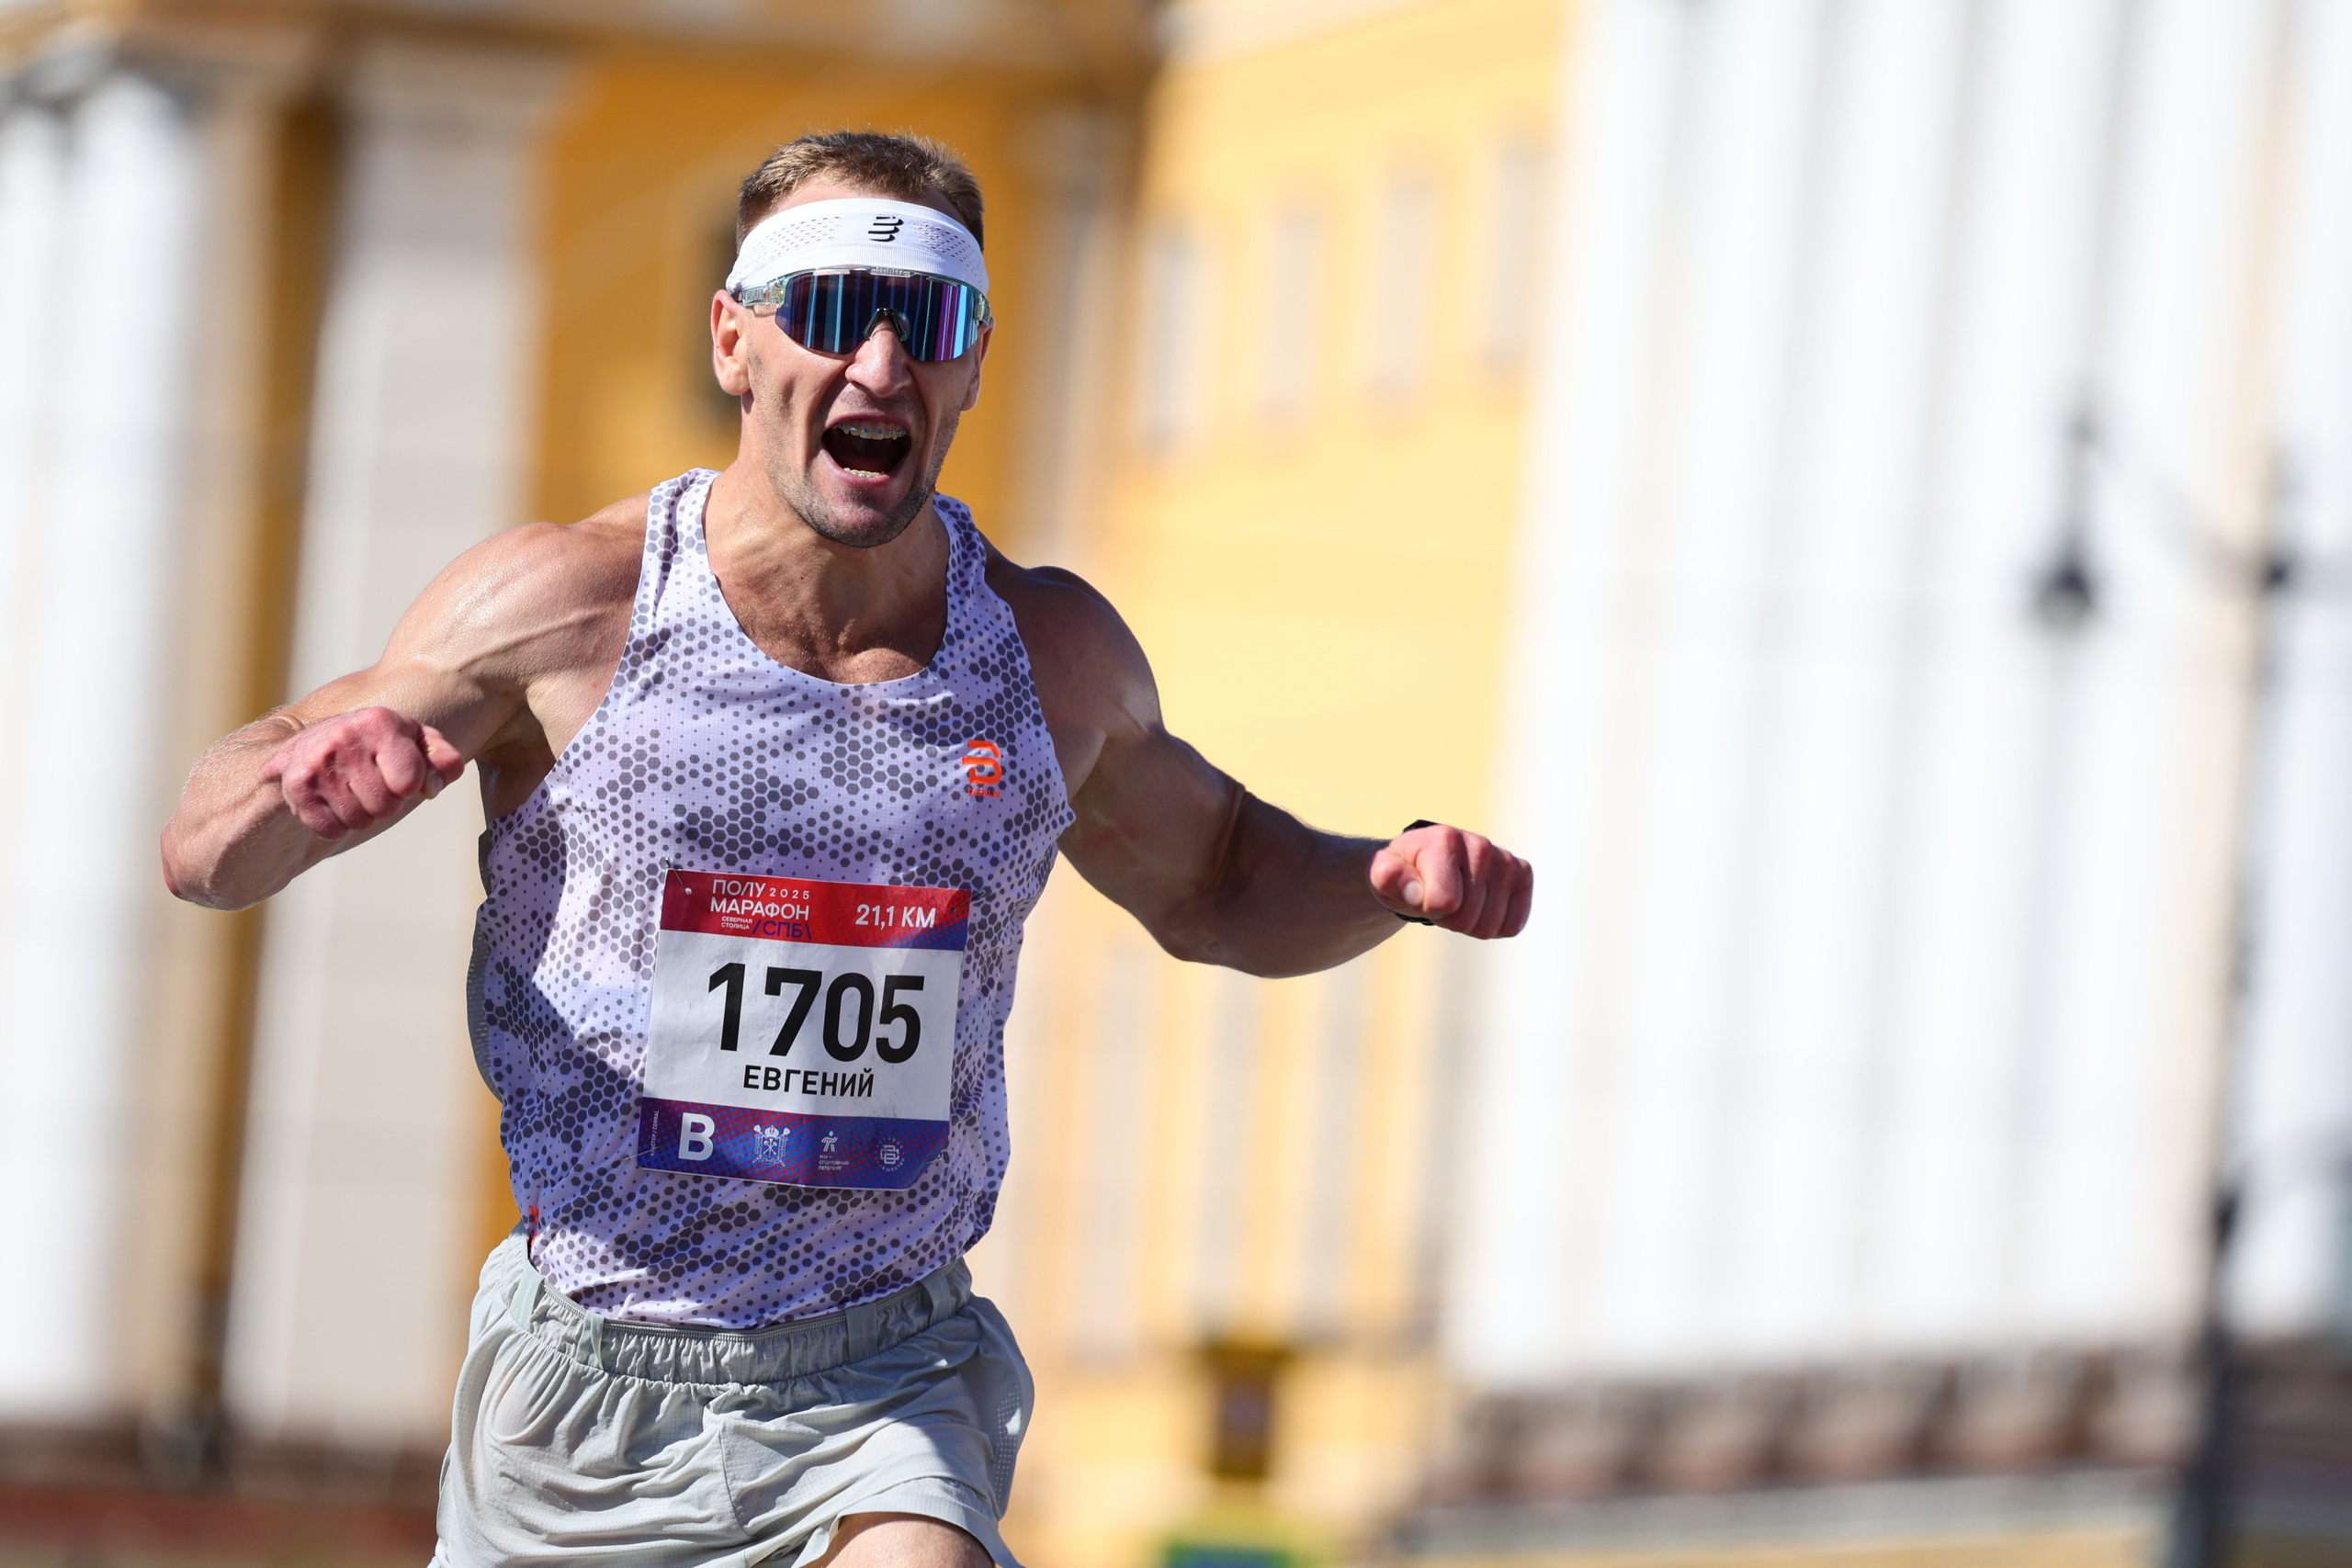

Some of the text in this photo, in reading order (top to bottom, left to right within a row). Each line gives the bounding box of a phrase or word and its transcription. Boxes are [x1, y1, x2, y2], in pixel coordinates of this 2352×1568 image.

[712, 878, 810, 899] ПОЛУ 2025
[710, 897, 809, 920] МАРАФОН
[721, 916, 752, 924] СЕВЕРНАЯ
[855, 903, 936, 931] 21,1 КМ
[707, 962, 925, 1064] 1705
[743, 1065, 875, 1098] ЕВГЕНИЙ
